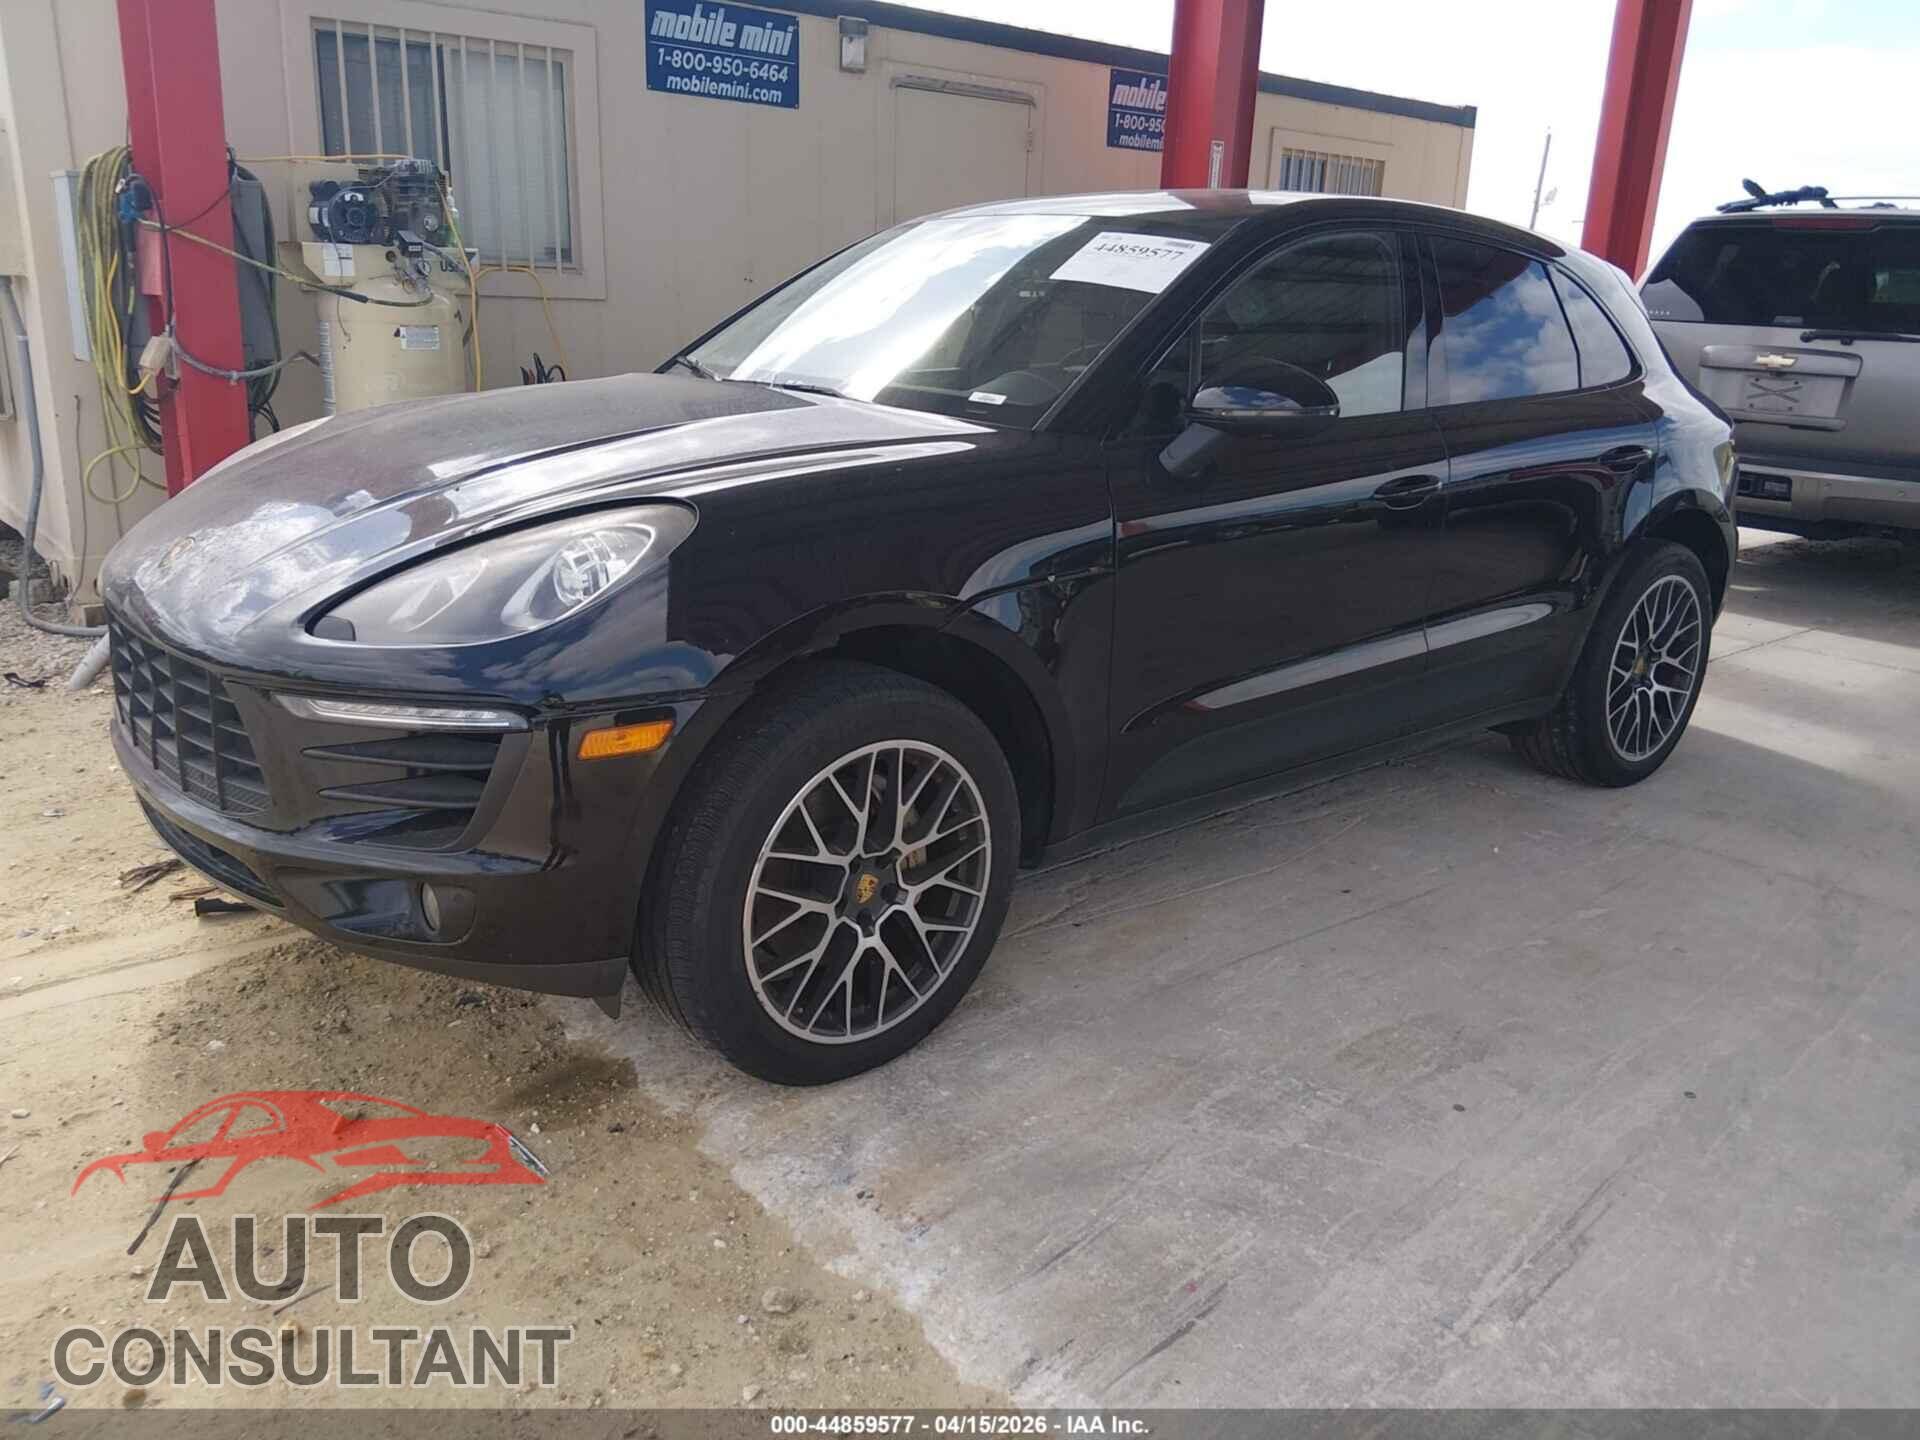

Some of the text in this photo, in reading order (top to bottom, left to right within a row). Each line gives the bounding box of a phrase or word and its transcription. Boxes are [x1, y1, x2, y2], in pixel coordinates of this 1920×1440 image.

[650, 3, 794, 56] mobile mini
[657, 48, 789, 83] 1-800-950-6464
[666, 75, 783, 103] mobilemini.com
[1111, 77, 1167, 112] mobile
